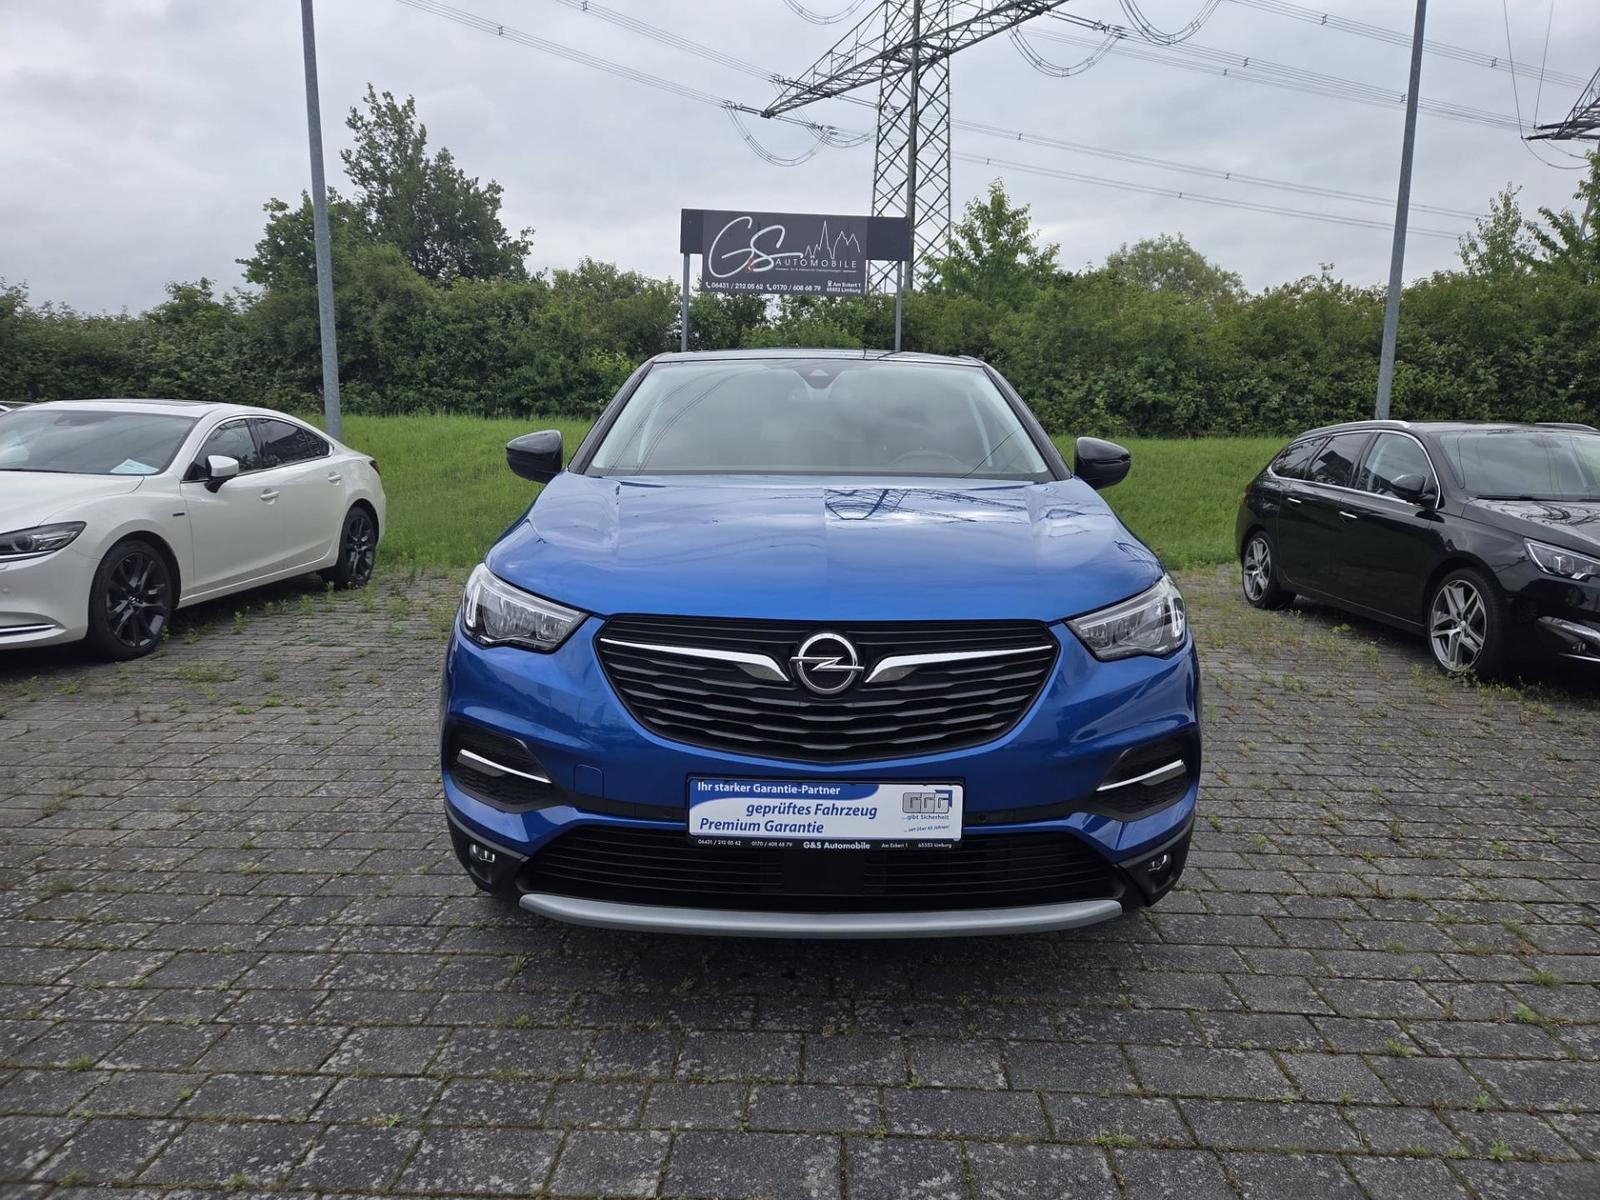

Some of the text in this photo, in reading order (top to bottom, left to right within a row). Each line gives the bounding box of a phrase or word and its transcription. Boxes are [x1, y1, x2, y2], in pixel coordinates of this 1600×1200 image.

[775, 258, 857, 269] AUTOMOBILE
[711, 281, 729, 289] 06431
[735, 282, 747, 290] 212
[697, 781, 841, 795] Ihr starker Garantie-Partner
[746, 802, 878, 820] geprüftes Fahrzeug
[699, 817, 824, 833] Premium Garantie
[803, 841, 871, 849] G&S Automobile
